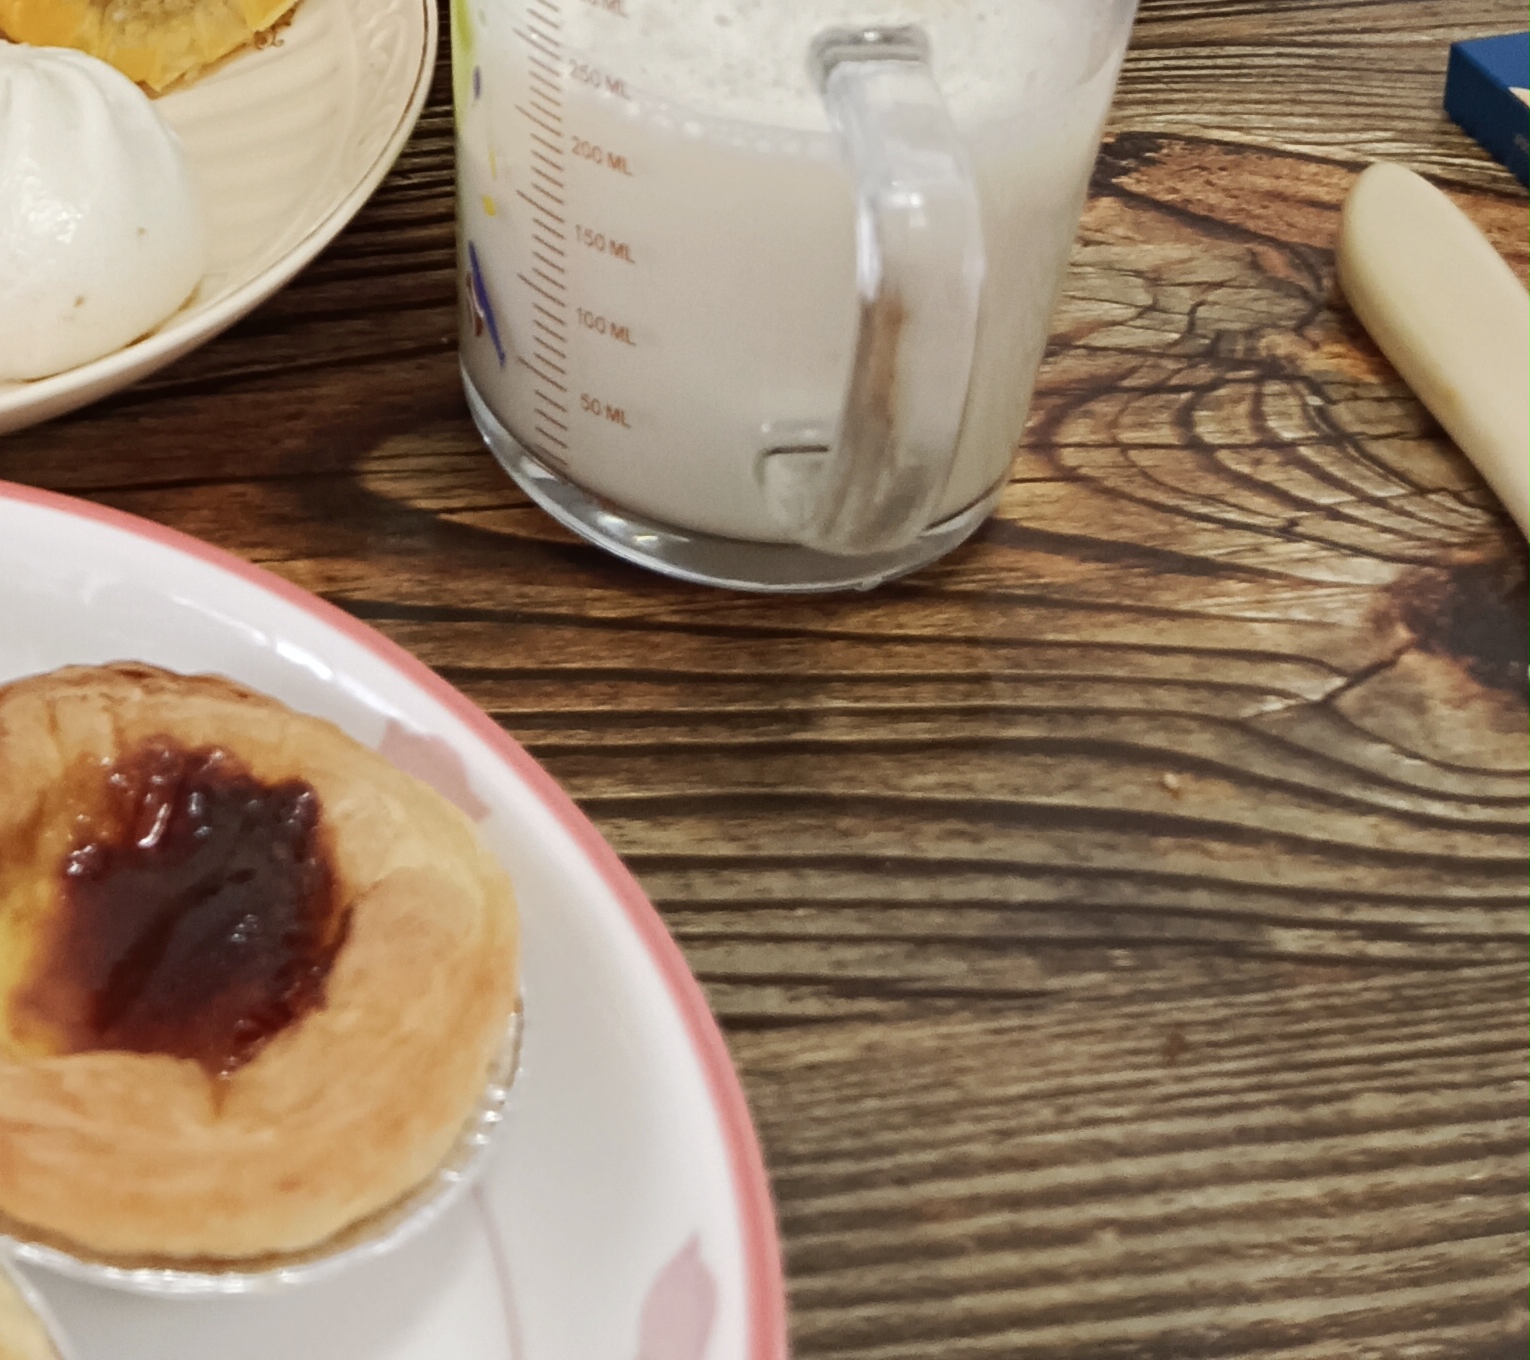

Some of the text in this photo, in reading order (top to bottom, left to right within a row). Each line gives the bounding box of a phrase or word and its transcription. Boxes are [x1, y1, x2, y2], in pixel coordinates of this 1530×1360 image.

[605, 74, 631, 100] ML
[571, 135, 633, 176] 200 ML
[575, 224, 636, 264] 150 ML
[576, 306, 636, 347] 100 ML
[580, 393, 631, 429] 50 ML
